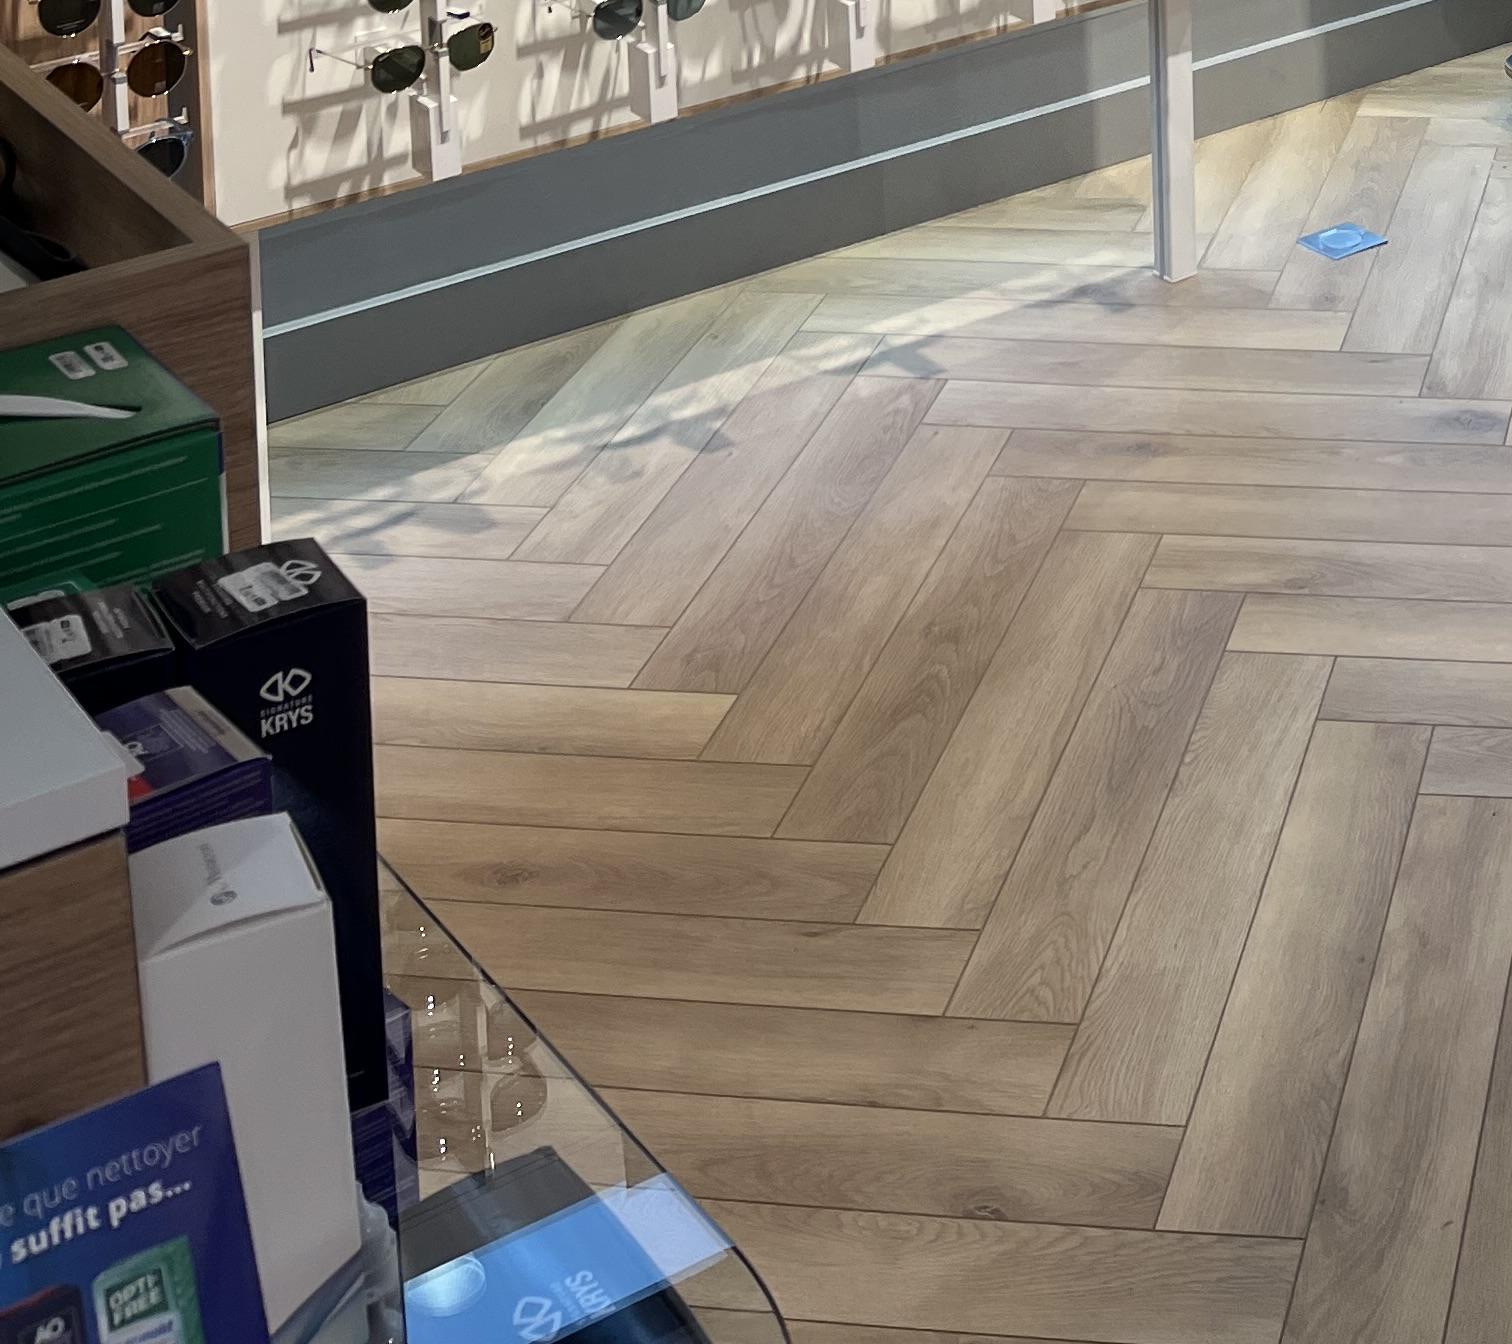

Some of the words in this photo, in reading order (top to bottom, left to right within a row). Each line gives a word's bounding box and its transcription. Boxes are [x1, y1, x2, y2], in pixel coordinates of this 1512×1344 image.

[260, 704, 314, 739] KRYS
[23, 1177, 79, 1219] que
[86, 1125, 201, 1190] nettoyer
[10, 1205, 102, 1265] suffit
[108, 1179, 192, 1229] pas...
